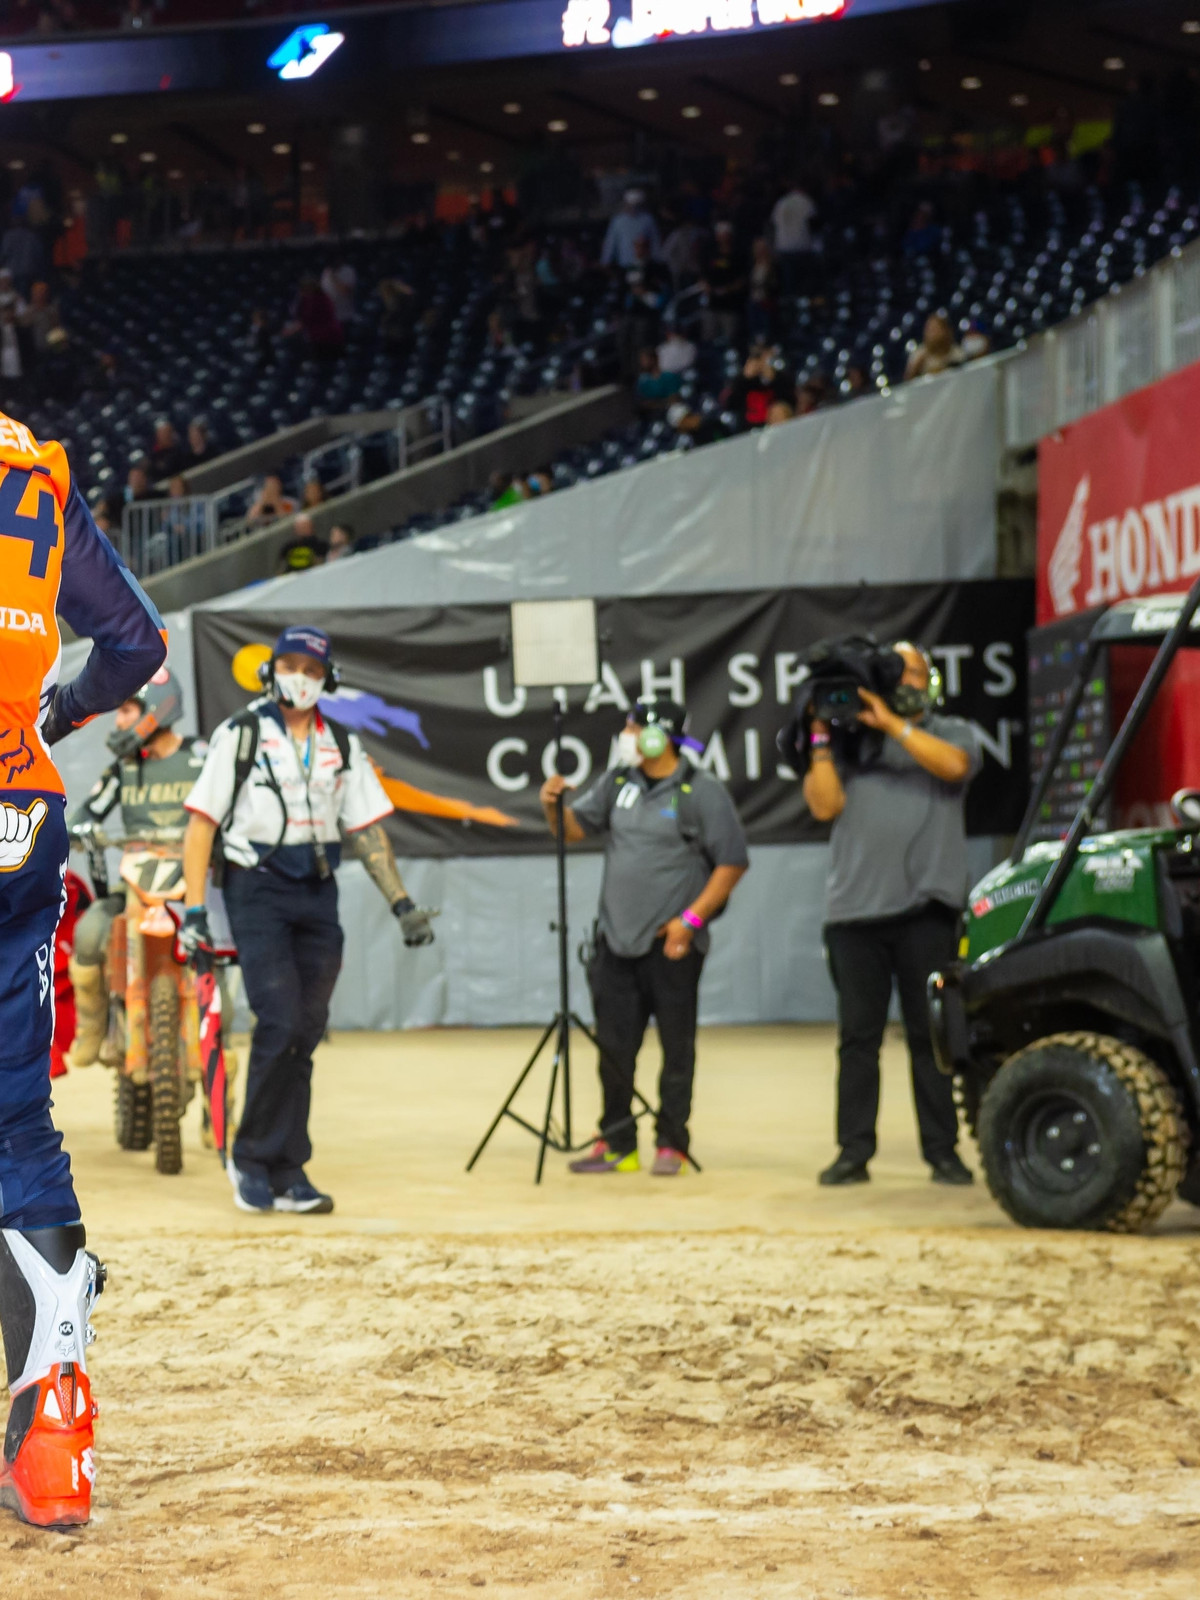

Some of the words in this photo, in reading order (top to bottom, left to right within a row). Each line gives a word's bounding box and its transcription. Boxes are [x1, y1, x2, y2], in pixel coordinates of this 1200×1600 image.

[483, 657, 685, 718] UAH
[726, 642, 1017, 707] SPTS
[134, 858, 184, 892] 17
